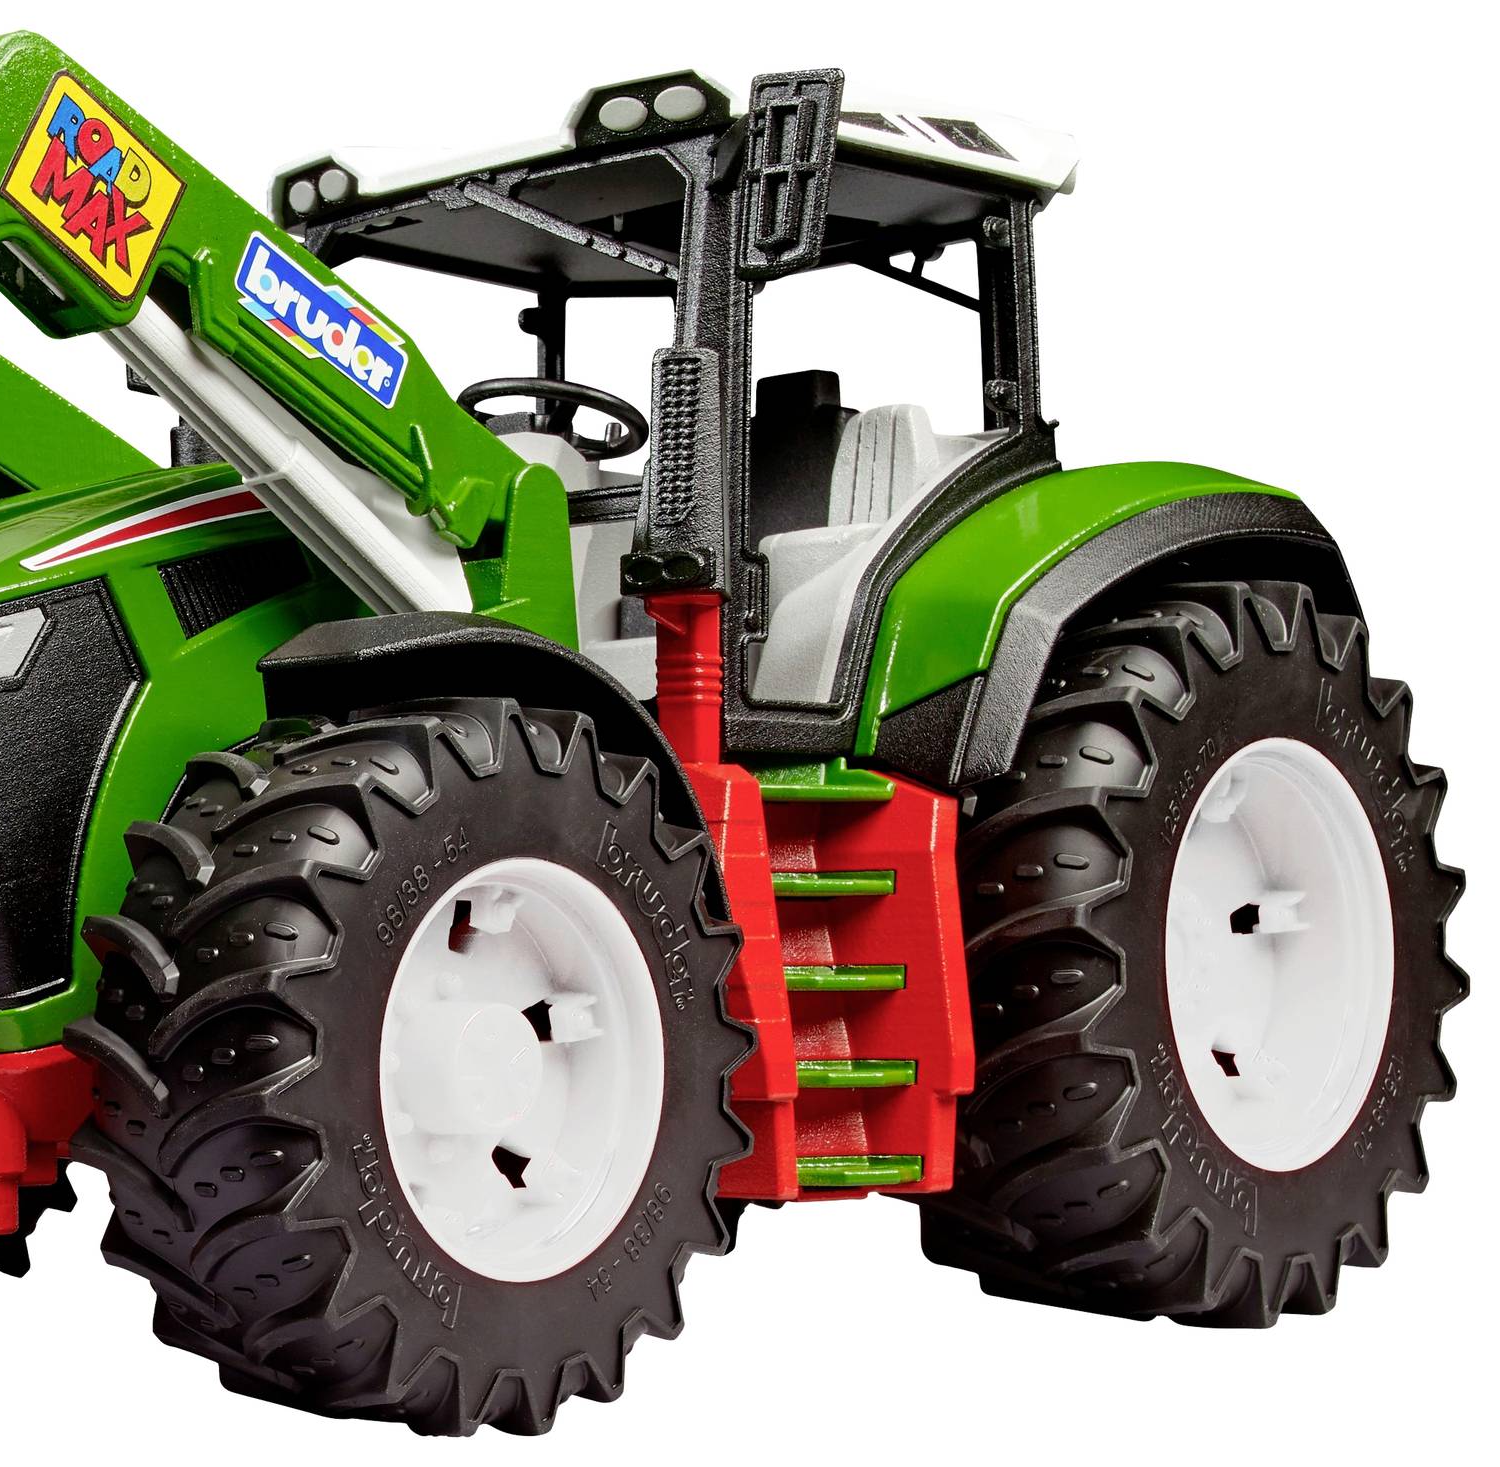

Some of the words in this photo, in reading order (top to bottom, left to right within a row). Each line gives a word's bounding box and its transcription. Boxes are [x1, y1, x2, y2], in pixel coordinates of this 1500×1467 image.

[30, 136, 153, 277] MAX
[46, 92, 152, 208] ROAD
[244, 244, 394, 392] bruder
[595, 819, 695, 1001] bruder
[351, 1142, 463, 1330] bruder
